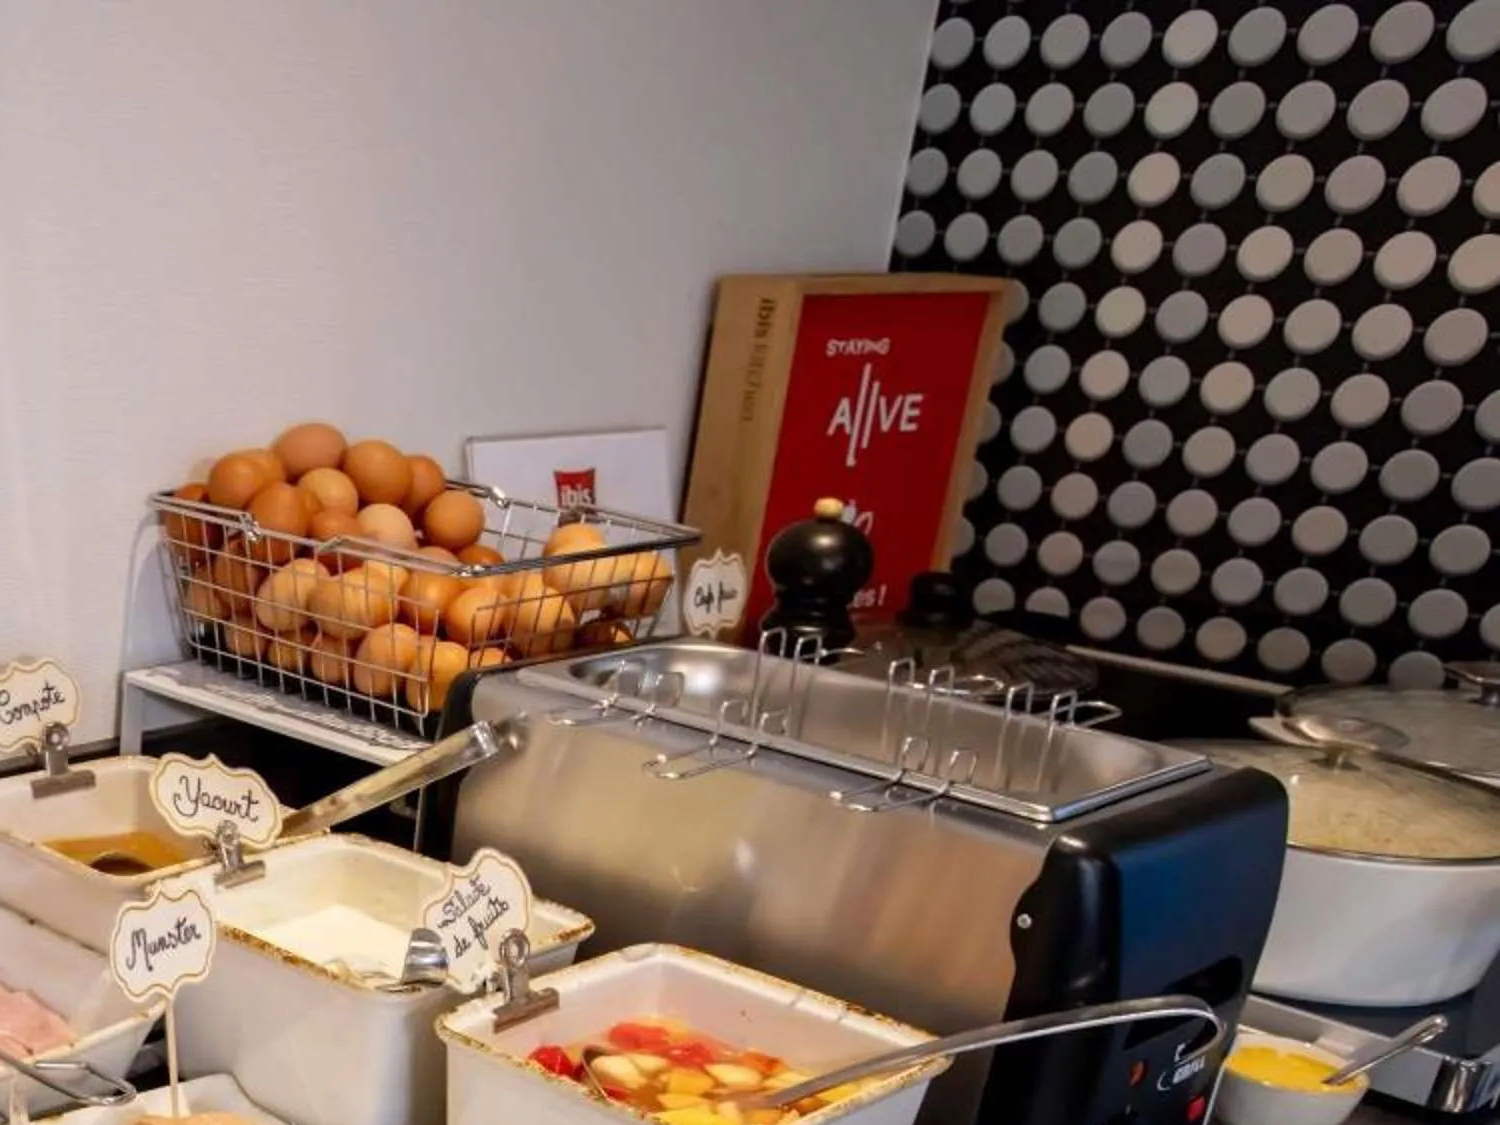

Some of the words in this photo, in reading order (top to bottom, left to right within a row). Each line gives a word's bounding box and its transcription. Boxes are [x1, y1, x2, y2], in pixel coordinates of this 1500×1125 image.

[826, 338, 891, 357] STAYING
[173, 776, 259, 823] Yaourt
[126, 916, 201, 971] Munster
